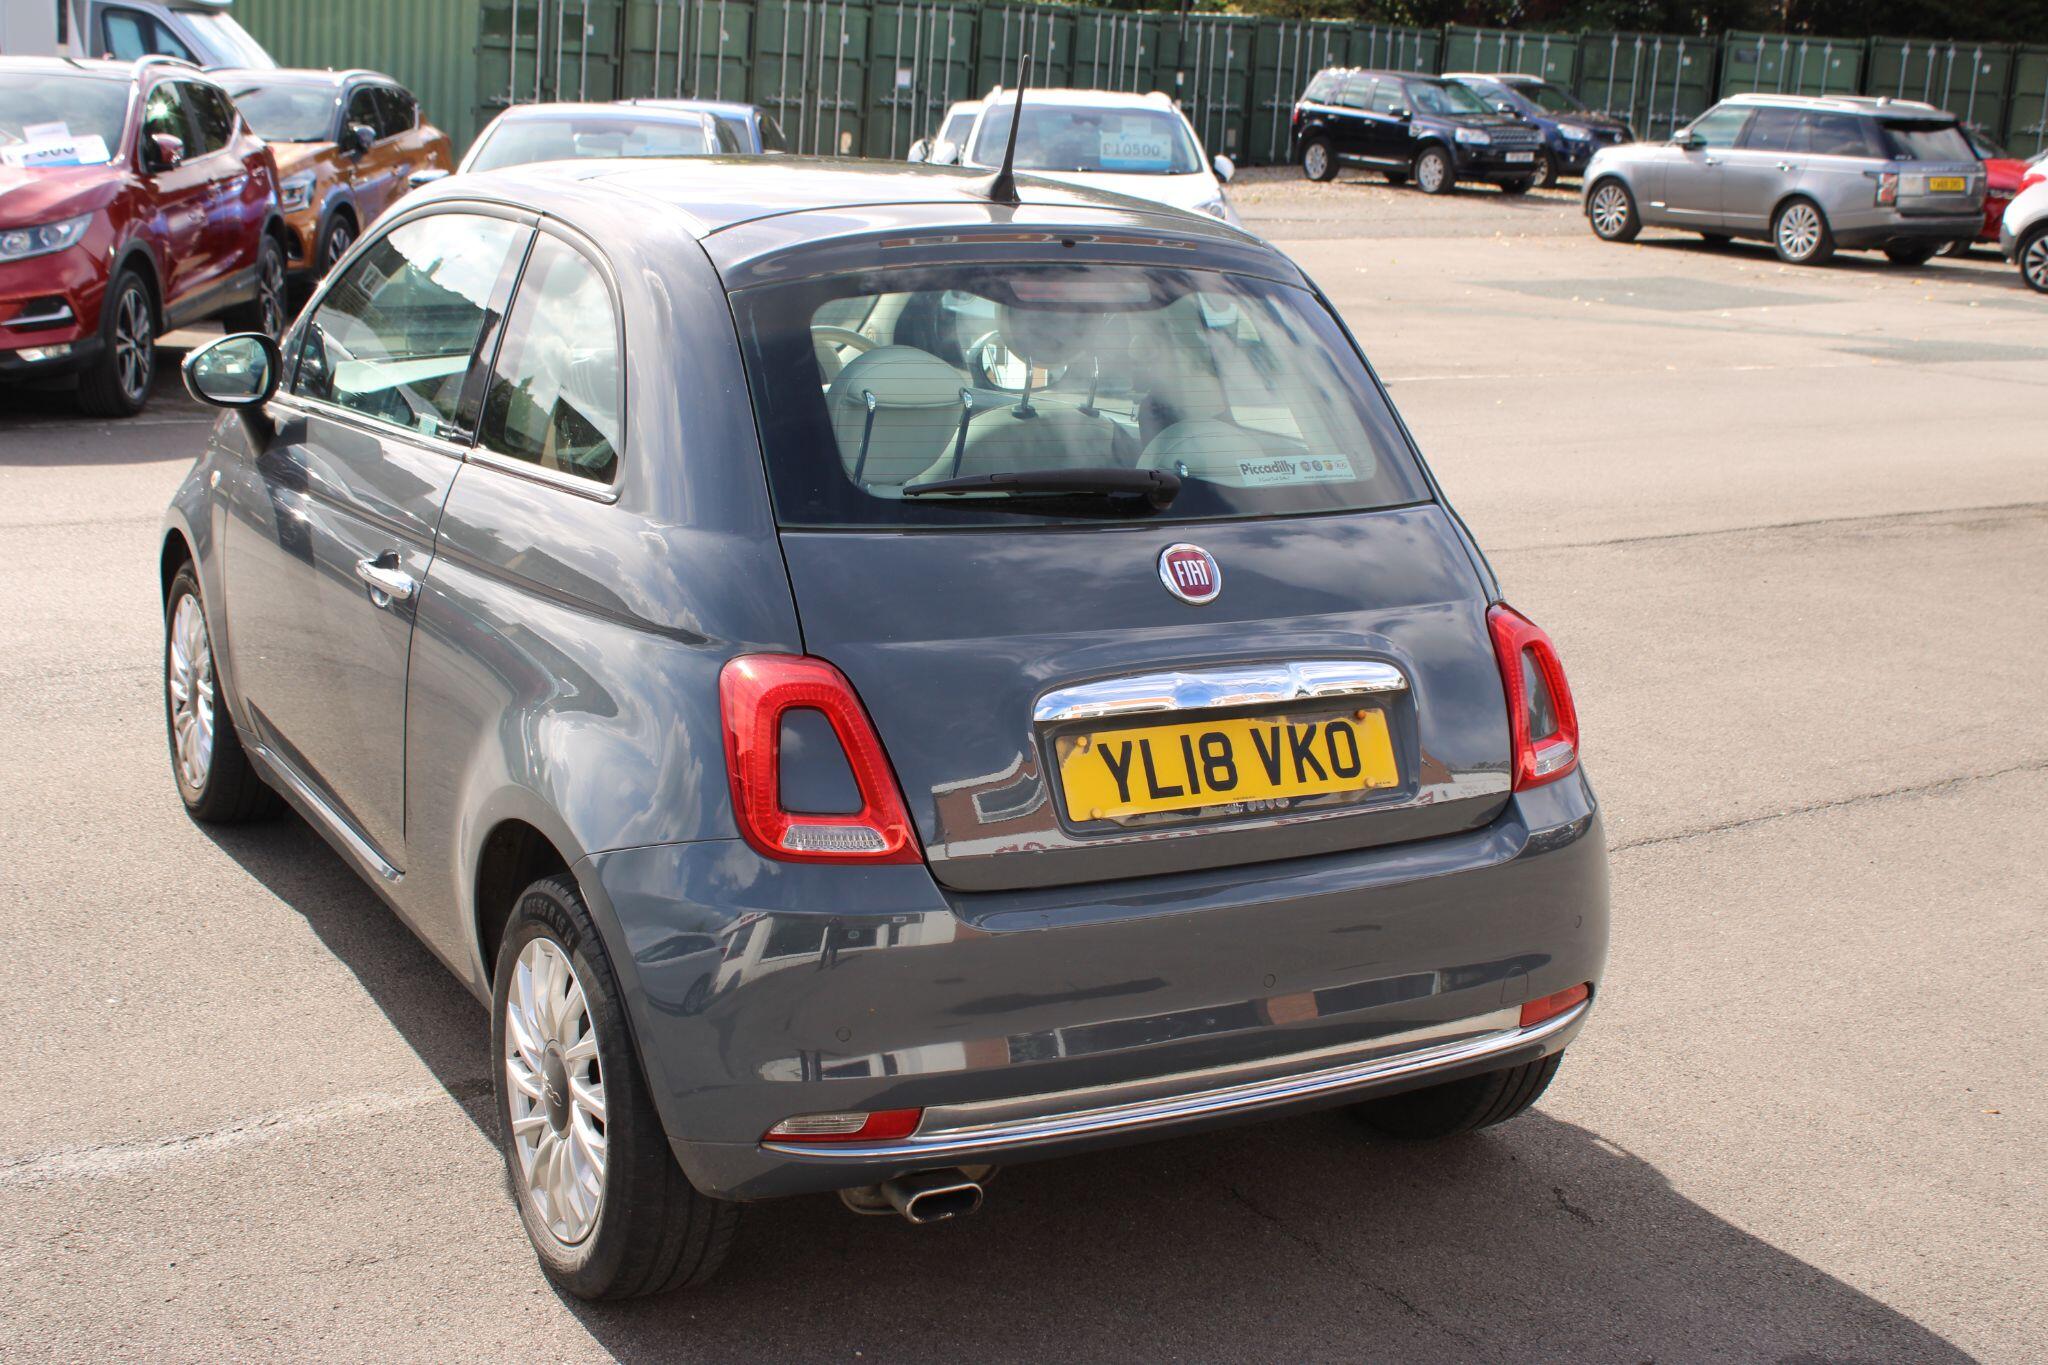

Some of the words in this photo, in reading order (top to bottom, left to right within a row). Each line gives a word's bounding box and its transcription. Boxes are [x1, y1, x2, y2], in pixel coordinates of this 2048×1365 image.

[1240, 460, 1296, 476] Piccadilly
[1173, 560, 1209, 587] FIAT
[1097, 731, 1238, 803] YL18
[1249, 720, 1361, 787] VKO
